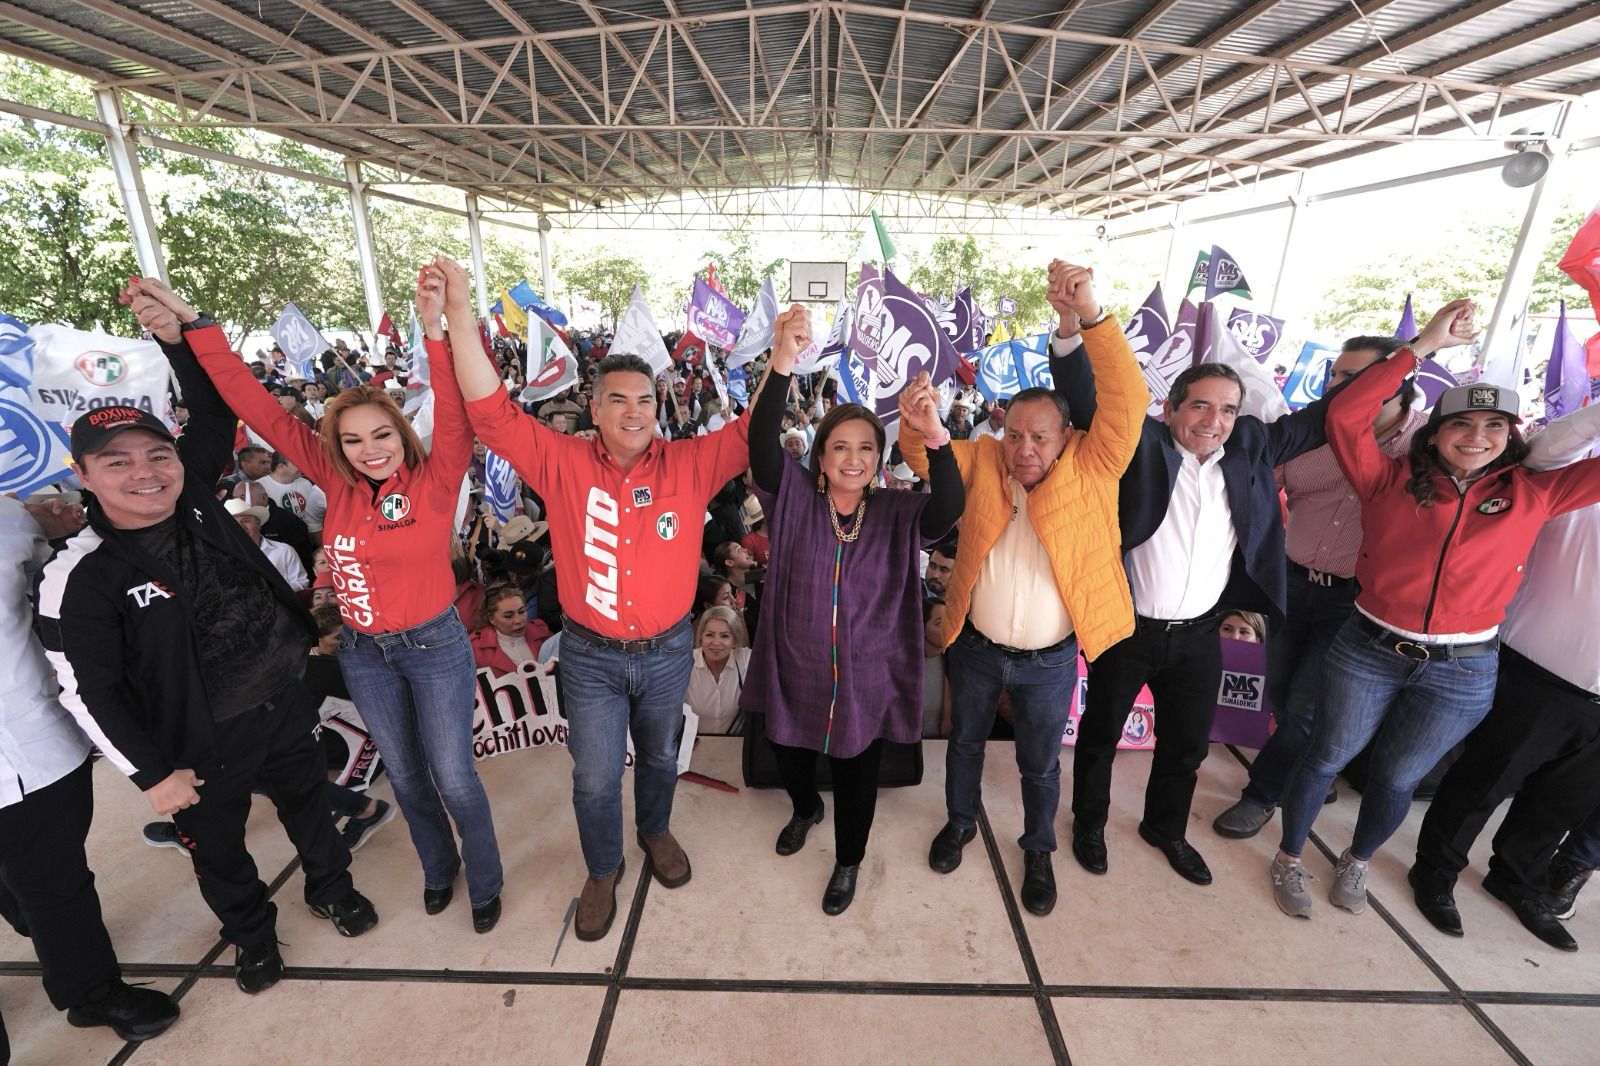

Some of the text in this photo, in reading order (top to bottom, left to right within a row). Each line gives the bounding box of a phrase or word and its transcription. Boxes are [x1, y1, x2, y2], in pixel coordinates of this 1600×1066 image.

[89, 408, 143, 425] BOXING
[324, 534, 373, 627] PAOLA GÁRATE
[584, 486, 618, 622] ALITO
[1222, 673, 1260, 701] PAS
